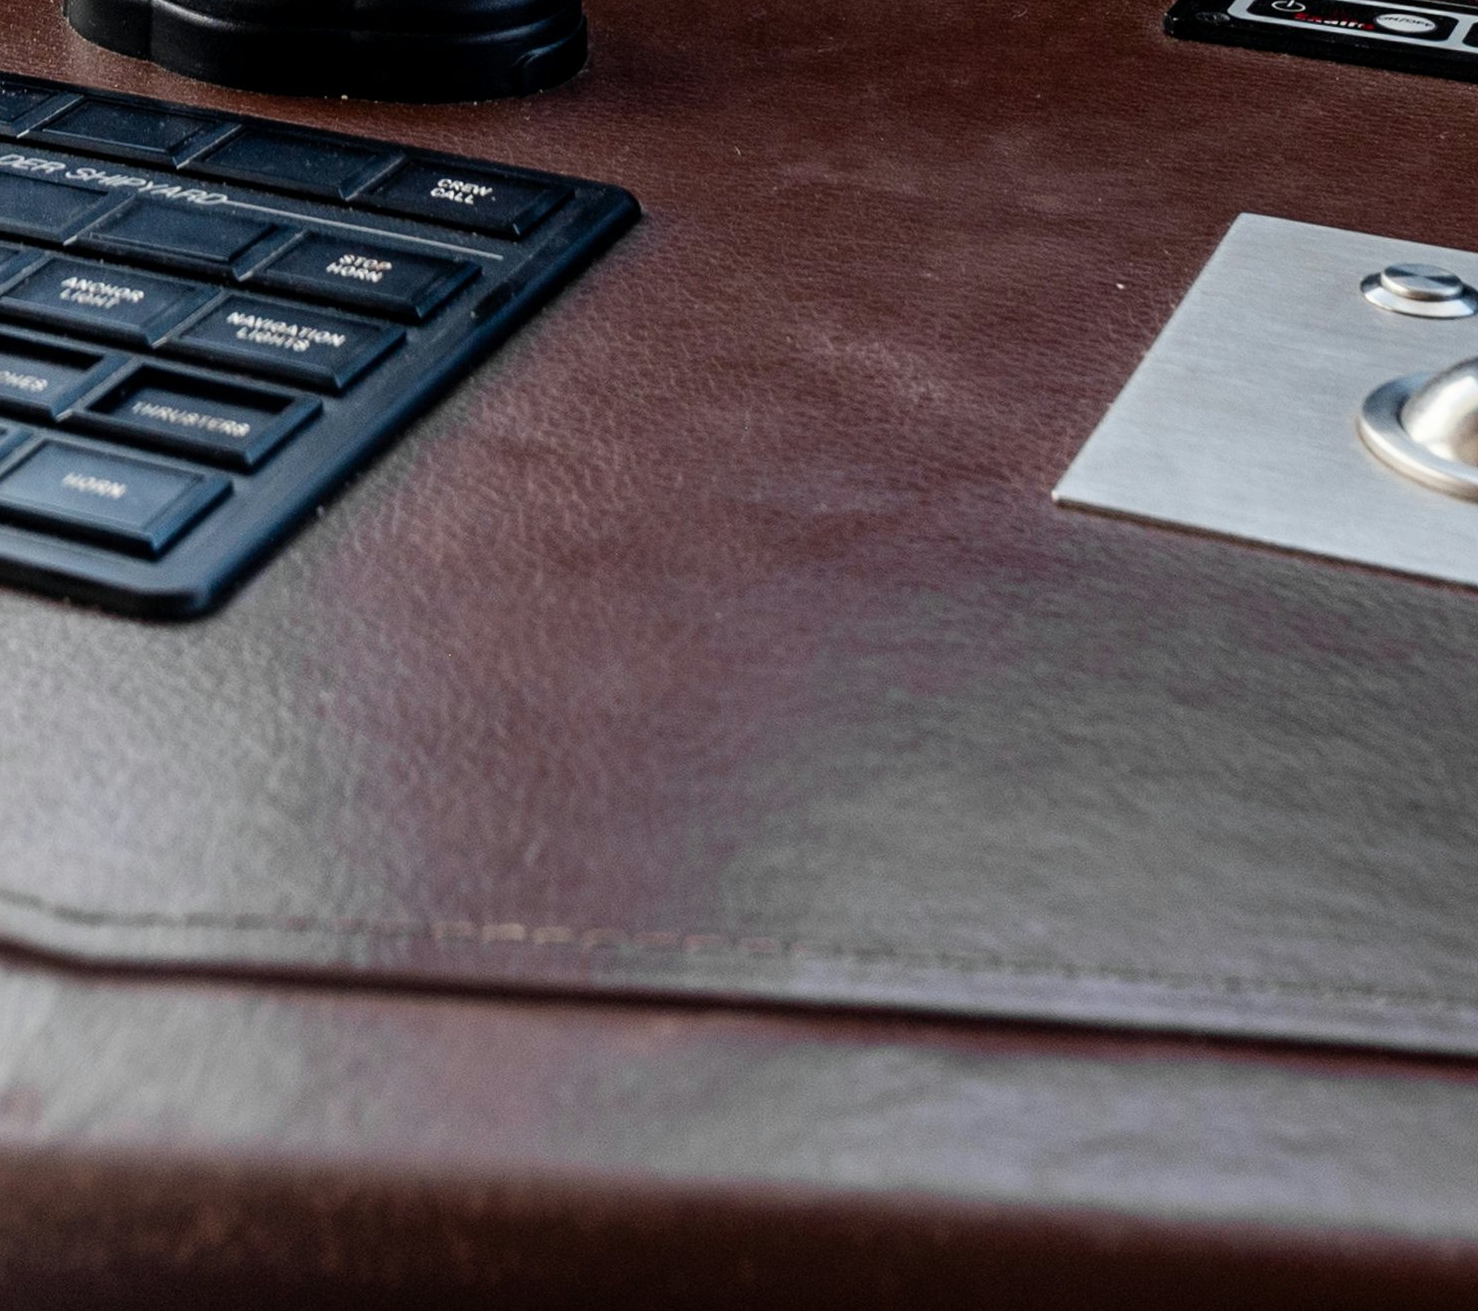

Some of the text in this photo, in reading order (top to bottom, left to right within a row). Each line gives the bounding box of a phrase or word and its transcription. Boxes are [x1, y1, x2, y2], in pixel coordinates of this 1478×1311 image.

[66, 167, 229, 206] SHIPYARD
[430, 187, 475, 205] CALL
[436, 178, 493, 197] CREW
[325, 262, 384, 284] HORN
[338, 254, 394, 272] STOP
[59, 287, 121, 309] LIGHT
[60, 276, 145, 304] ANCHOR
[226, 311, 347, 348] NAVIGATION
[236, 327, 311, 353] LIGHTS
[131, 400, 252, 438] THRUSTERS
[61, 471, 128, 500] HORN
